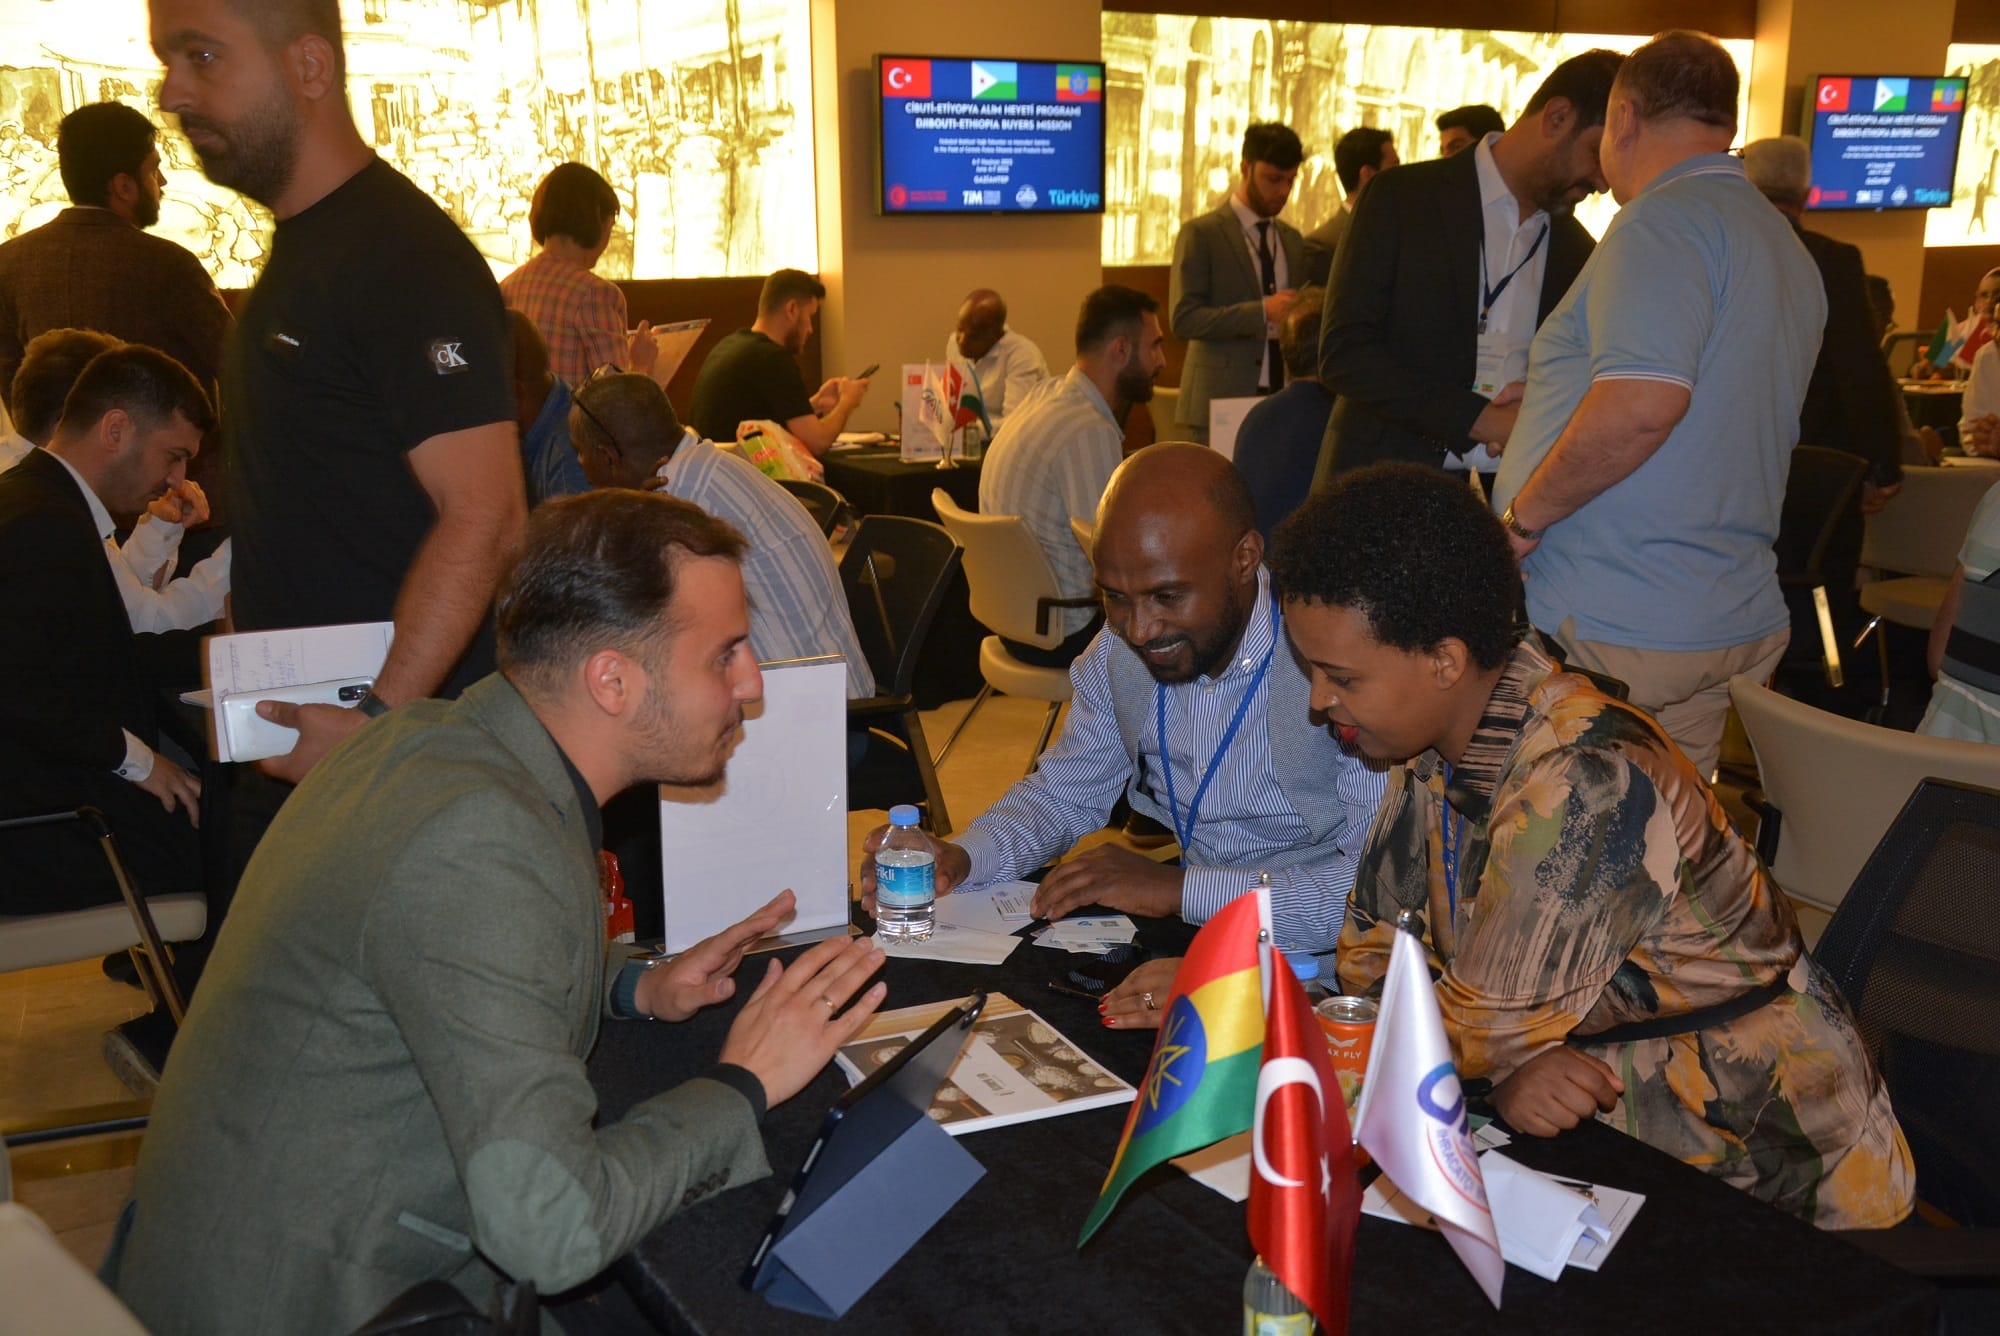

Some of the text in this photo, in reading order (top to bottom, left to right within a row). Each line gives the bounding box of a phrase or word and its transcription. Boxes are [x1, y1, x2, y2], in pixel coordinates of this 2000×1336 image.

[1001, 119, 1035, 130] BUYERS
[1036, 120, 1072, 131] MISSION
[1048, 189, 1100, 209] Türkiye
[1343, 1050, 1361, 1060] FLY
